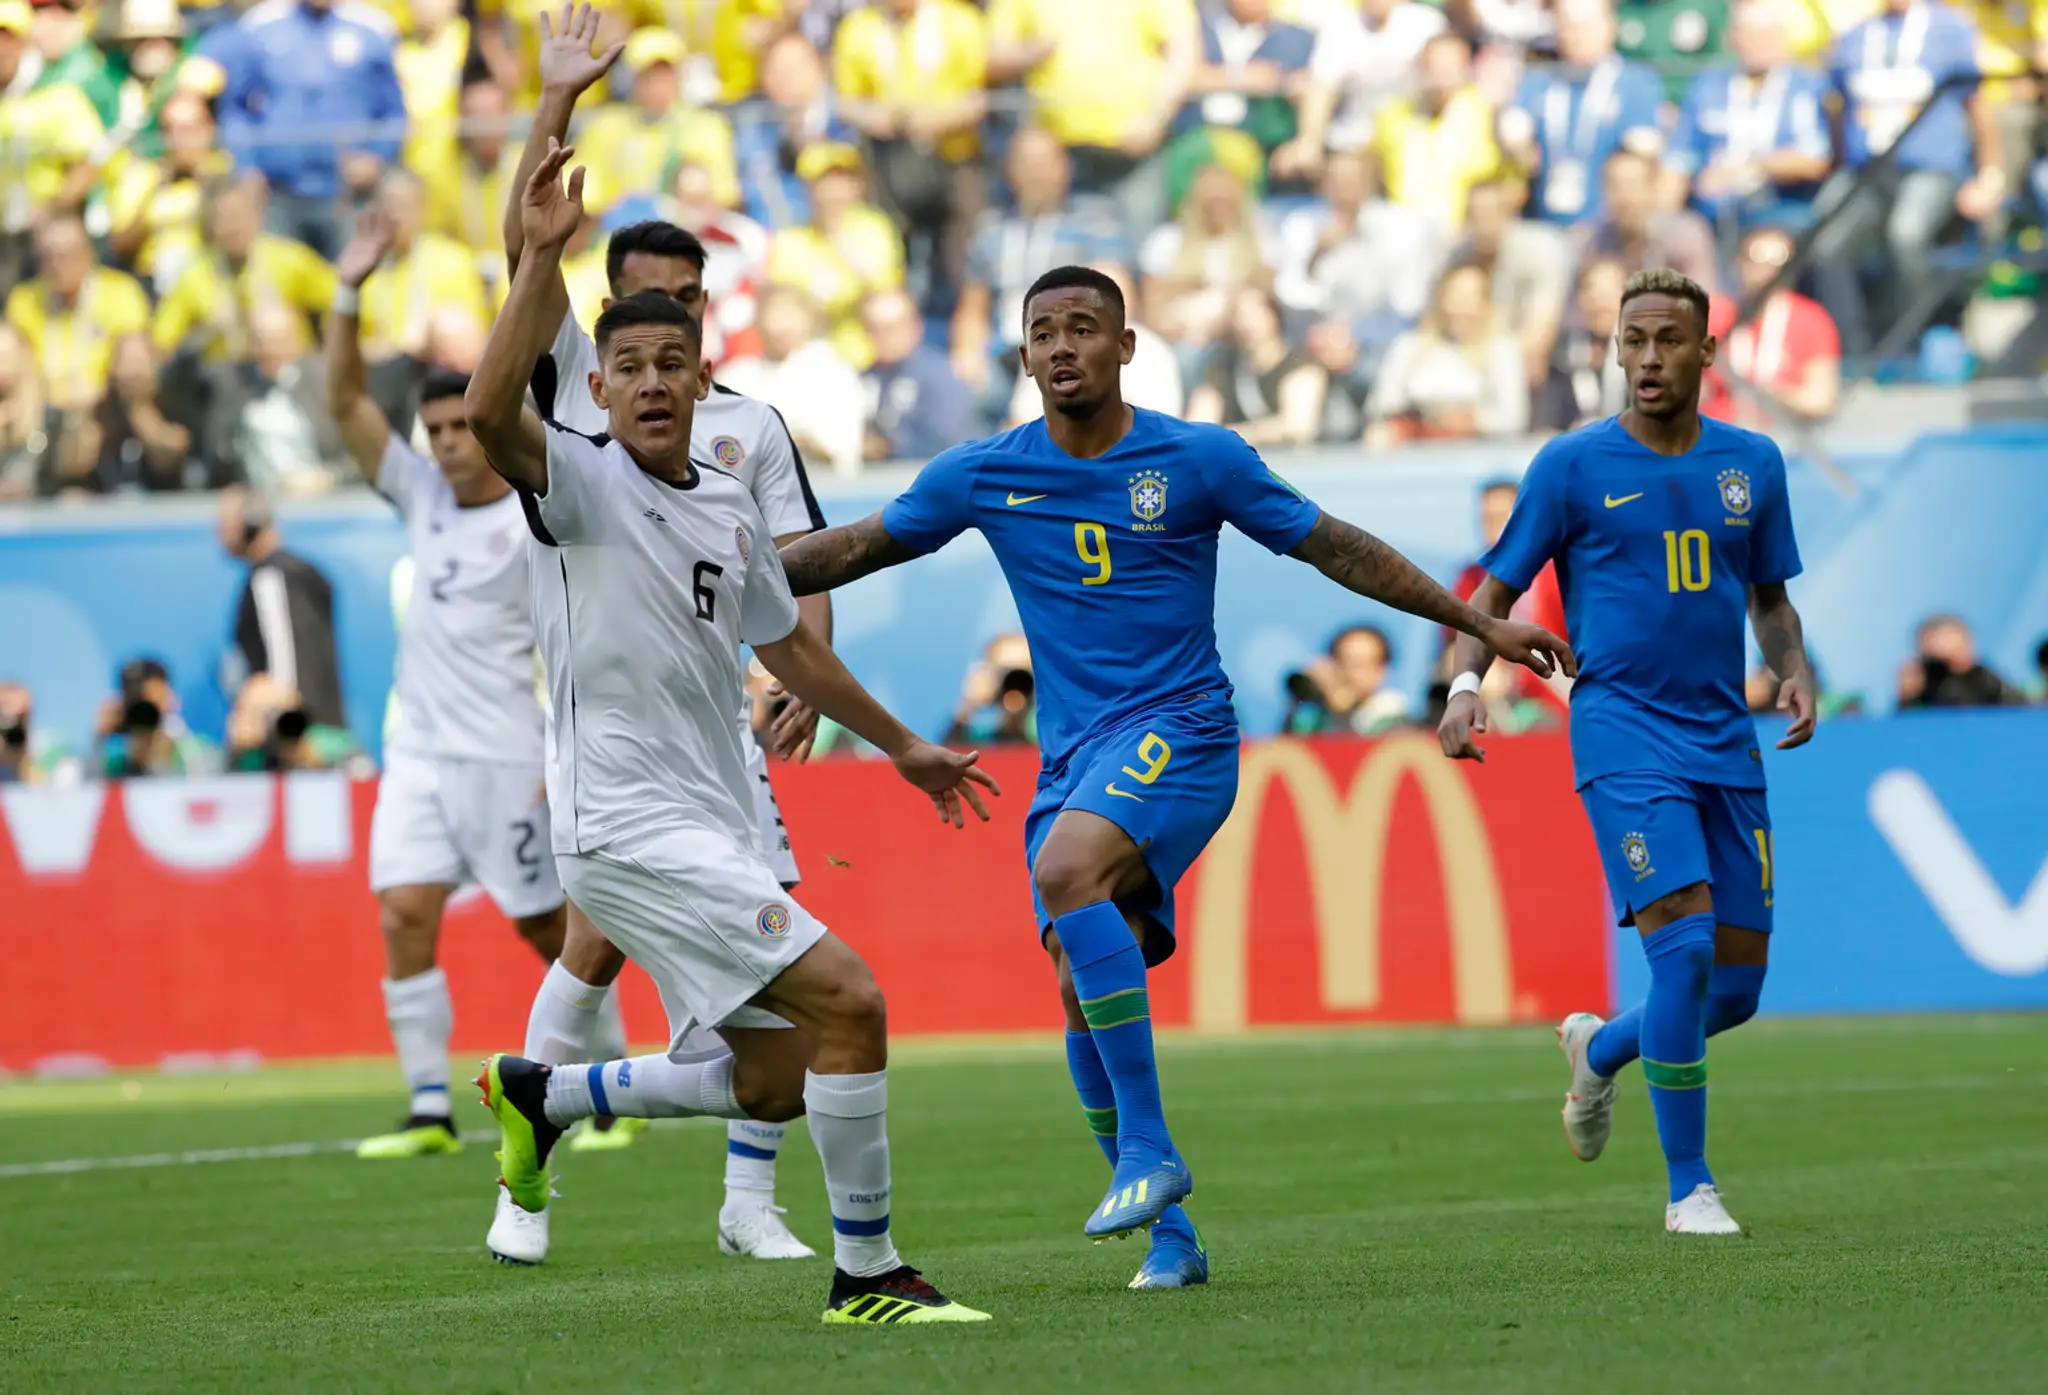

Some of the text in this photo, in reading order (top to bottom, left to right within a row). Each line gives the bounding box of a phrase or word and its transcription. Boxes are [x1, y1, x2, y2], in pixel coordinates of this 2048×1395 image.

[1074, 522, 1112, 586] 9
[1131, 523, 1166, 531] BRASIL
[430, 557, 460, 603] 2
[1663, 529, 1711, 594] 10
[692, 560, 724, 623] 6
[1122, 732, 1172, 785] 9
[507, 821, 541, 867] 2
[1753, 828, 1775, 891] 1
